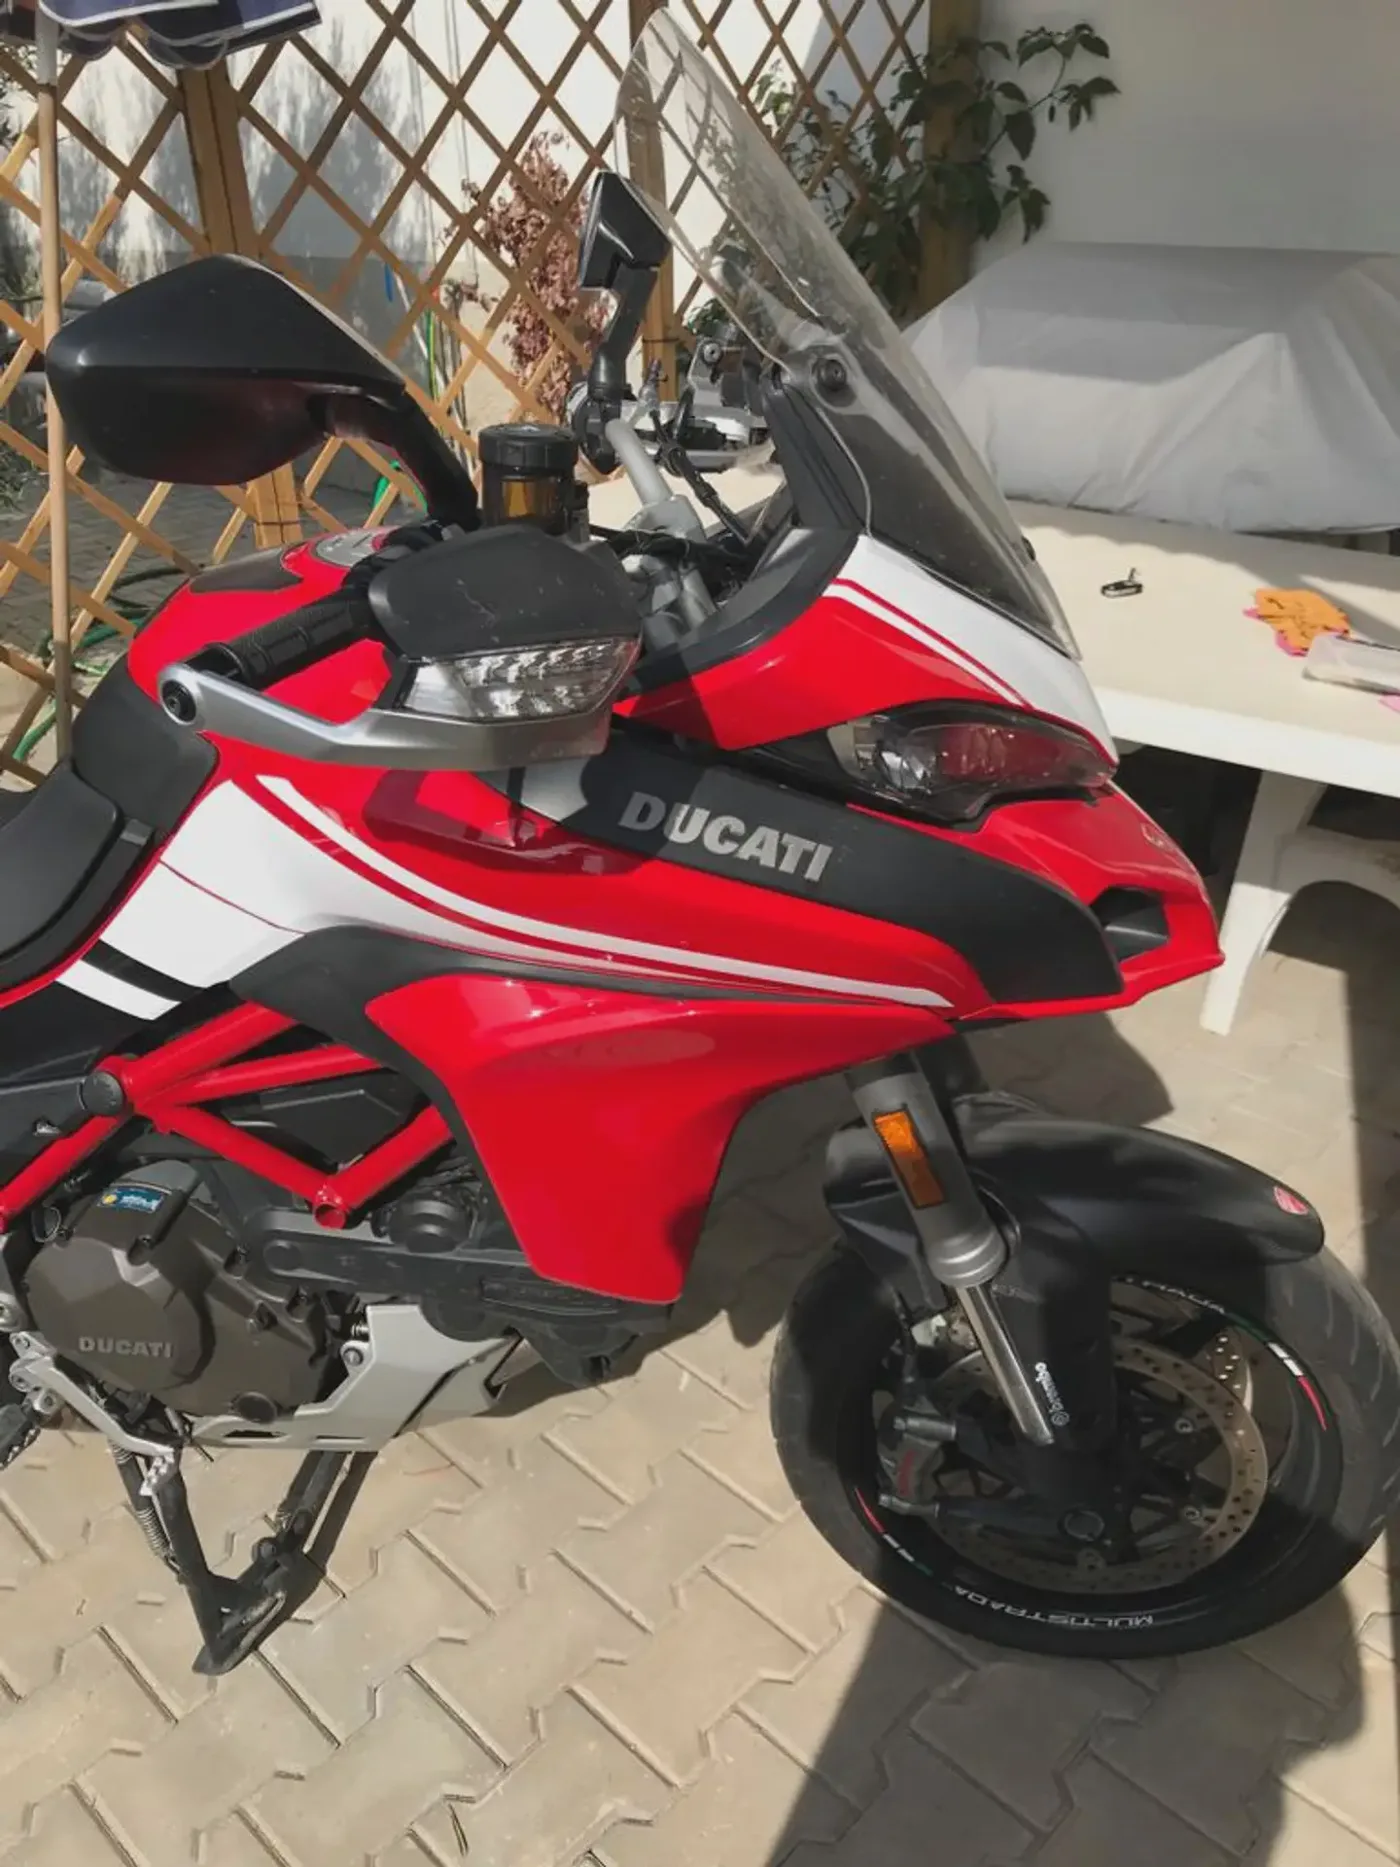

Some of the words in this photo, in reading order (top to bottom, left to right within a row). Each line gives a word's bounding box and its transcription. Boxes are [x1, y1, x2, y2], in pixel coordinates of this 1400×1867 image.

[618, 792, 833, 882] DUCATI
[78, 1337, 173, 1358] DUCATI
[954, 1585, 1153, 1629] MULTISTRADA
